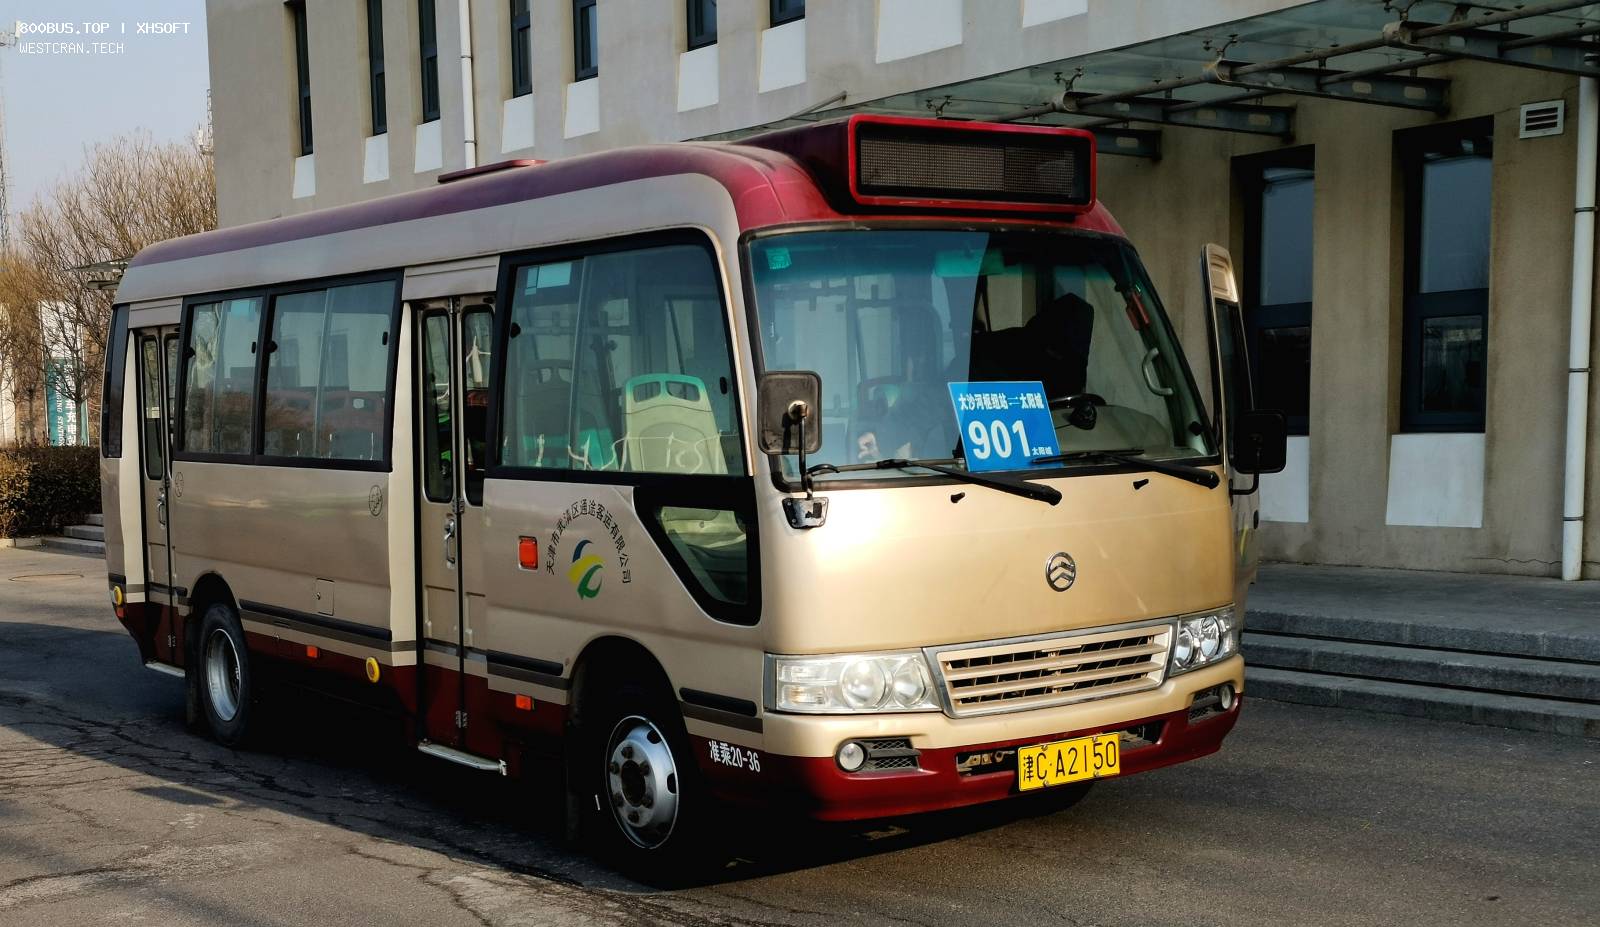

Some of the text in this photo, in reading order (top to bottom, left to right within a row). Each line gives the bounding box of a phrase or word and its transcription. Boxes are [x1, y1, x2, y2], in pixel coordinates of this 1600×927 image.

[1019, 393, 1045, 410] 太阳城
[968, 420, 1031, 460] 901
[546, 498, 632, 584] 天津市武清区通途客运有限公司
